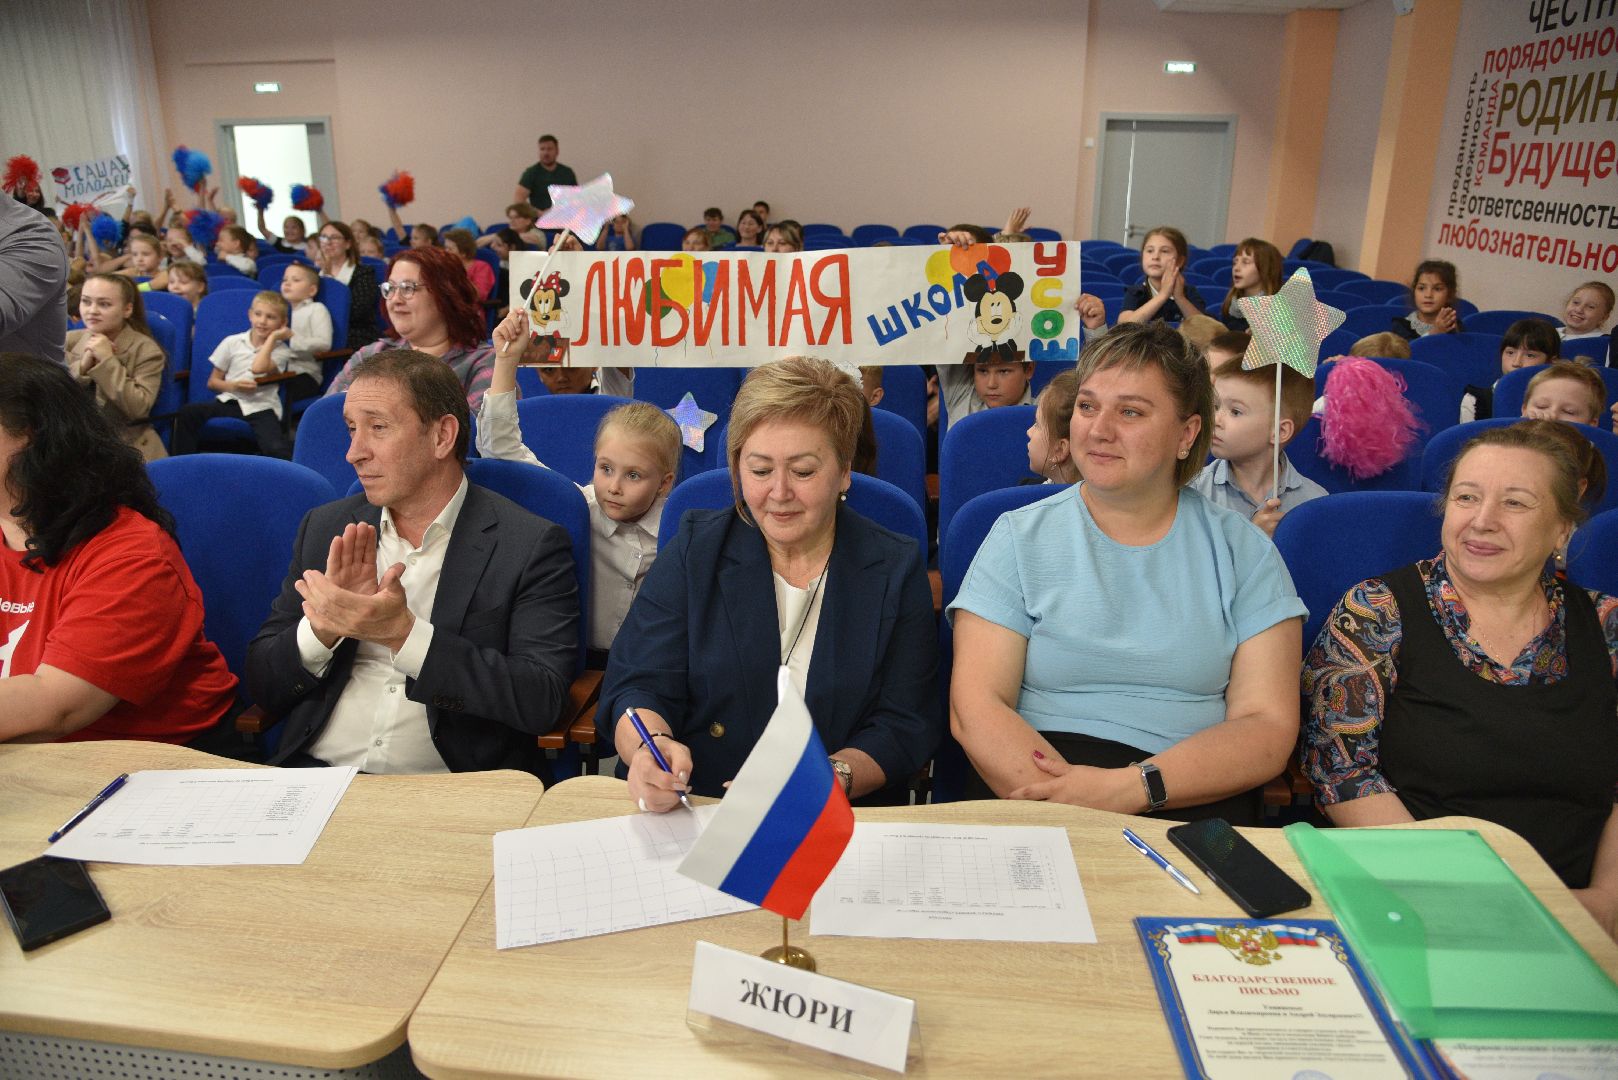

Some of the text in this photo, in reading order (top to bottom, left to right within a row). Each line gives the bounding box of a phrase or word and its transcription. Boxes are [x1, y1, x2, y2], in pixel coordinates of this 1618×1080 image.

[1482, 27, 1618, 79] порядочно
[1474, 79, 1500, 187] КОМАНДА
[1496, 70, 1618, 135] РОДИН
[1447, 72, 1478, 216] преданность
[1457, 79, 1488, 219] надежность
[1488, 131, 1618, 189] Будуще
[571, 253, 1000, 347] ЛЮБИМАЯ ШКОЛА
[739, 978, 856, 1034] ЖЮРИ
[1192, 973, 1337, 986] БЛАГОДАРСТВЕННОЕ
[1239, 986, 1300, 996] ПИСЬМО
